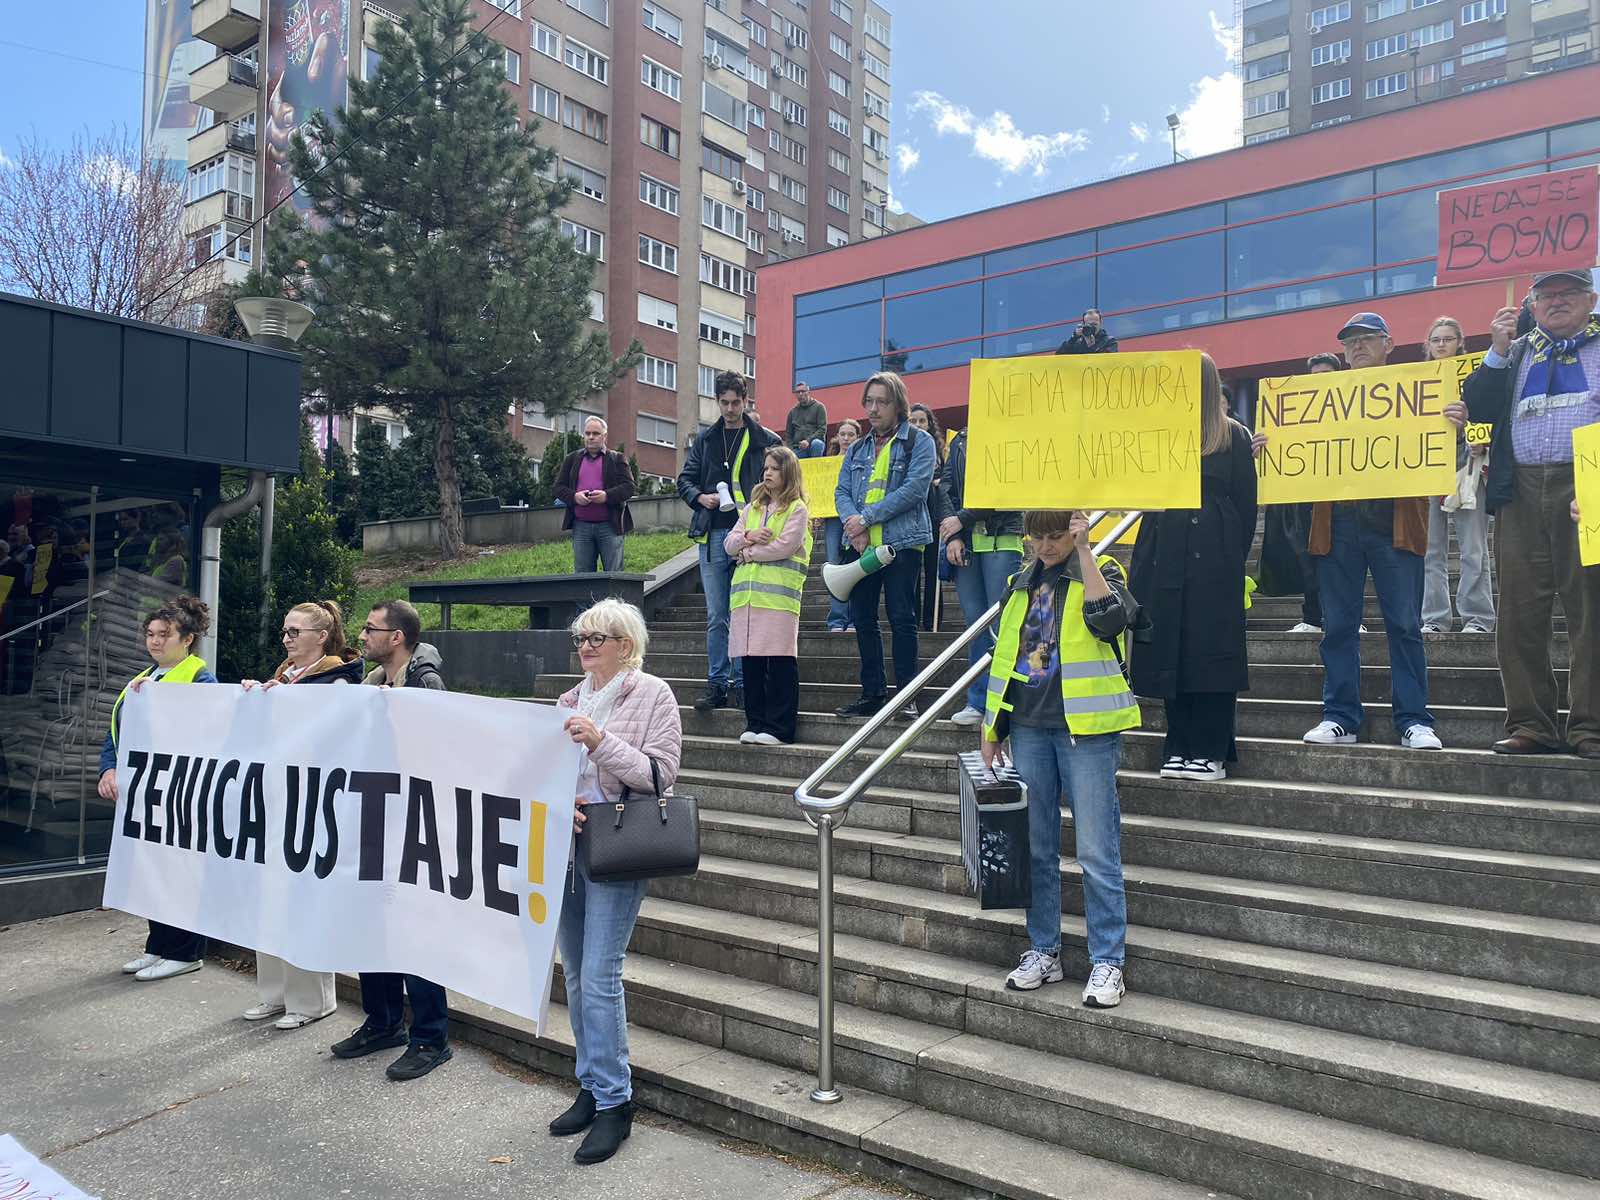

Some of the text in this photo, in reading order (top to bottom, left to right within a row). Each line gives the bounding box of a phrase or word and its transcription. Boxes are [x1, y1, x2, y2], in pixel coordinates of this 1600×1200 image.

[1548, 174, 1585, 201] SE
[1445, 212, 1589, 271] BOSNO
[986, 364, 1195, 417] NEMA ODGOVORA,
[1261, 379, 1443, 428] NEZAVISNE
[983, 428, 1200, 486] NEMA NAPRETKA
[1259, 431, 1448, 478] INSTITUCIJE
[122, 750, 548, 925] ZENICA USTAJE!
